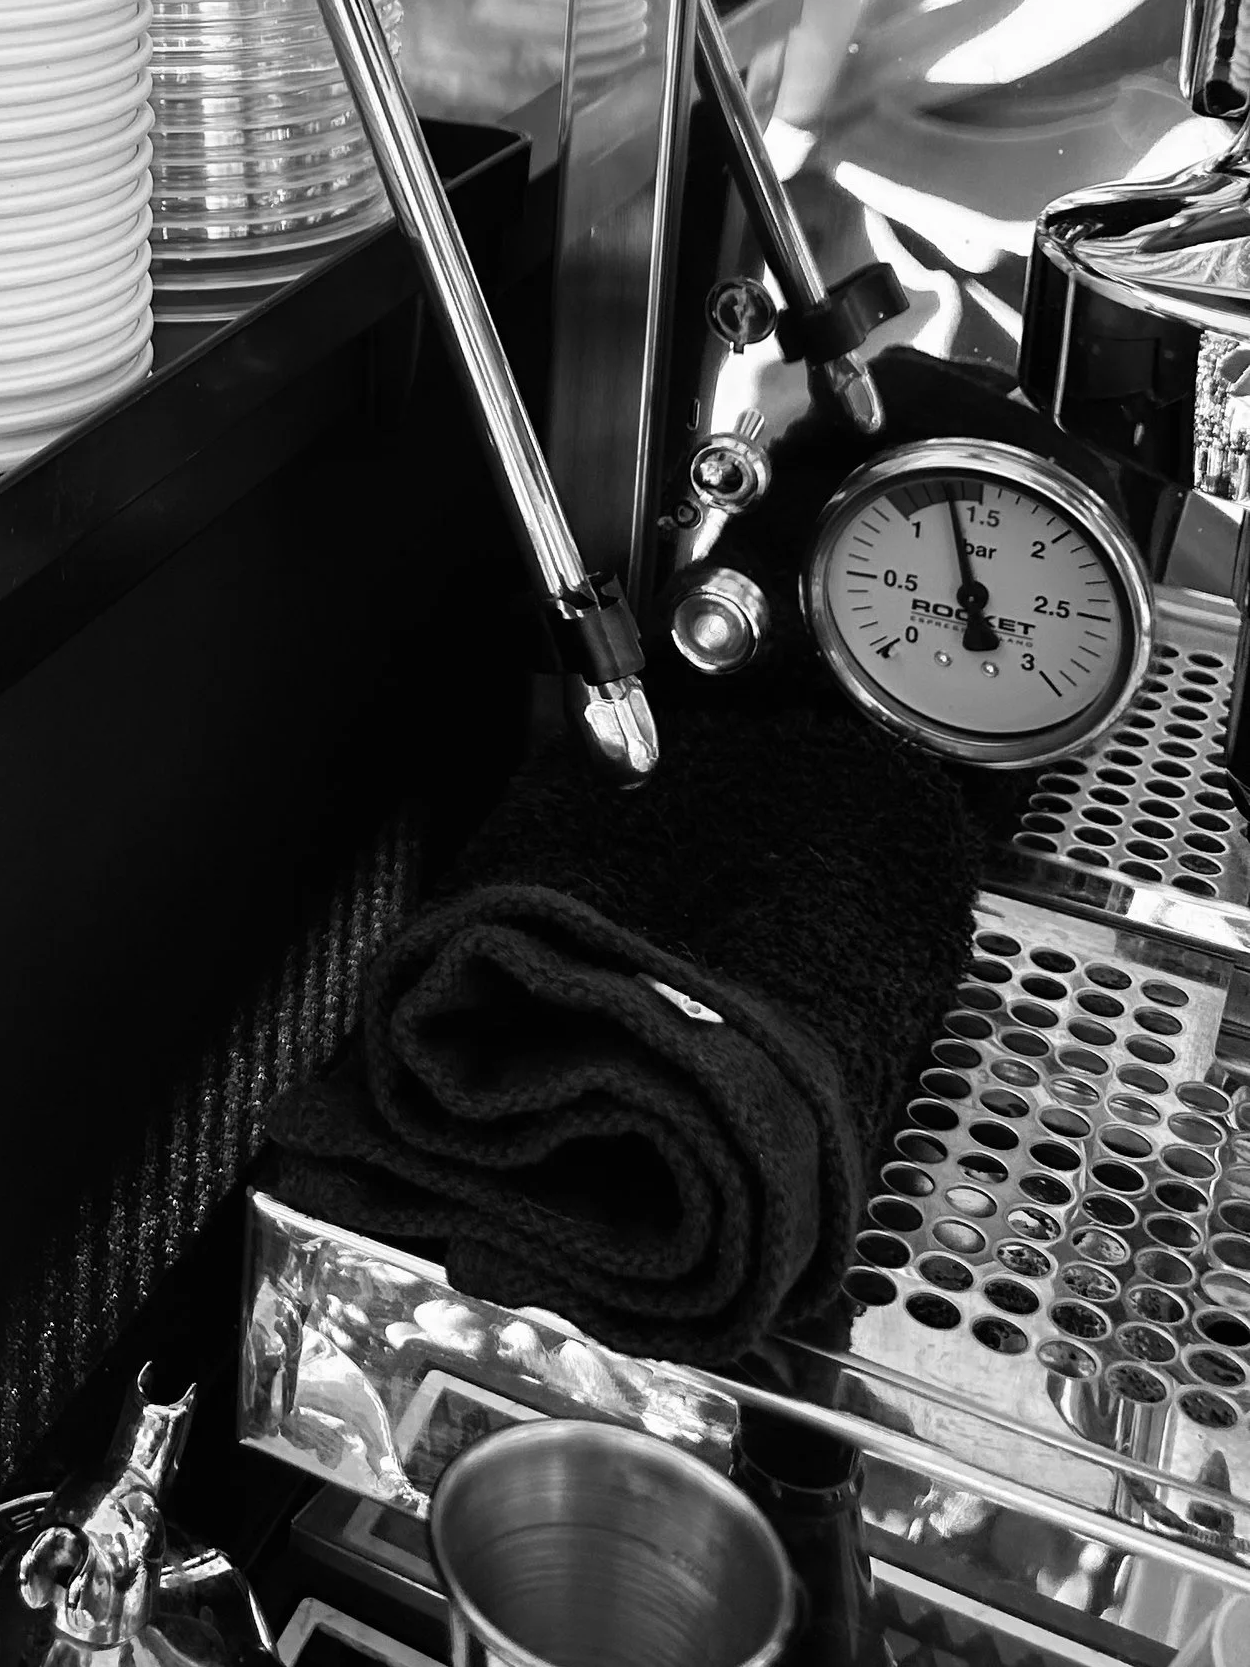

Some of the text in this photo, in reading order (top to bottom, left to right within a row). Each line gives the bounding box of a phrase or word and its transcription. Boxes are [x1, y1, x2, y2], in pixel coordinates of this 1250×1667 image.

[965, 505, 1001, 528] 1.5
[911, 521, 922, 539] 1
[1030, 540, 1046, 560] 2
[883, 569, 918, 592] 0.5
[1033, 596, 1071, 619] 2.5
[905, 627, 919, 644] 0
[1021, 653, 1035, 672] 3
